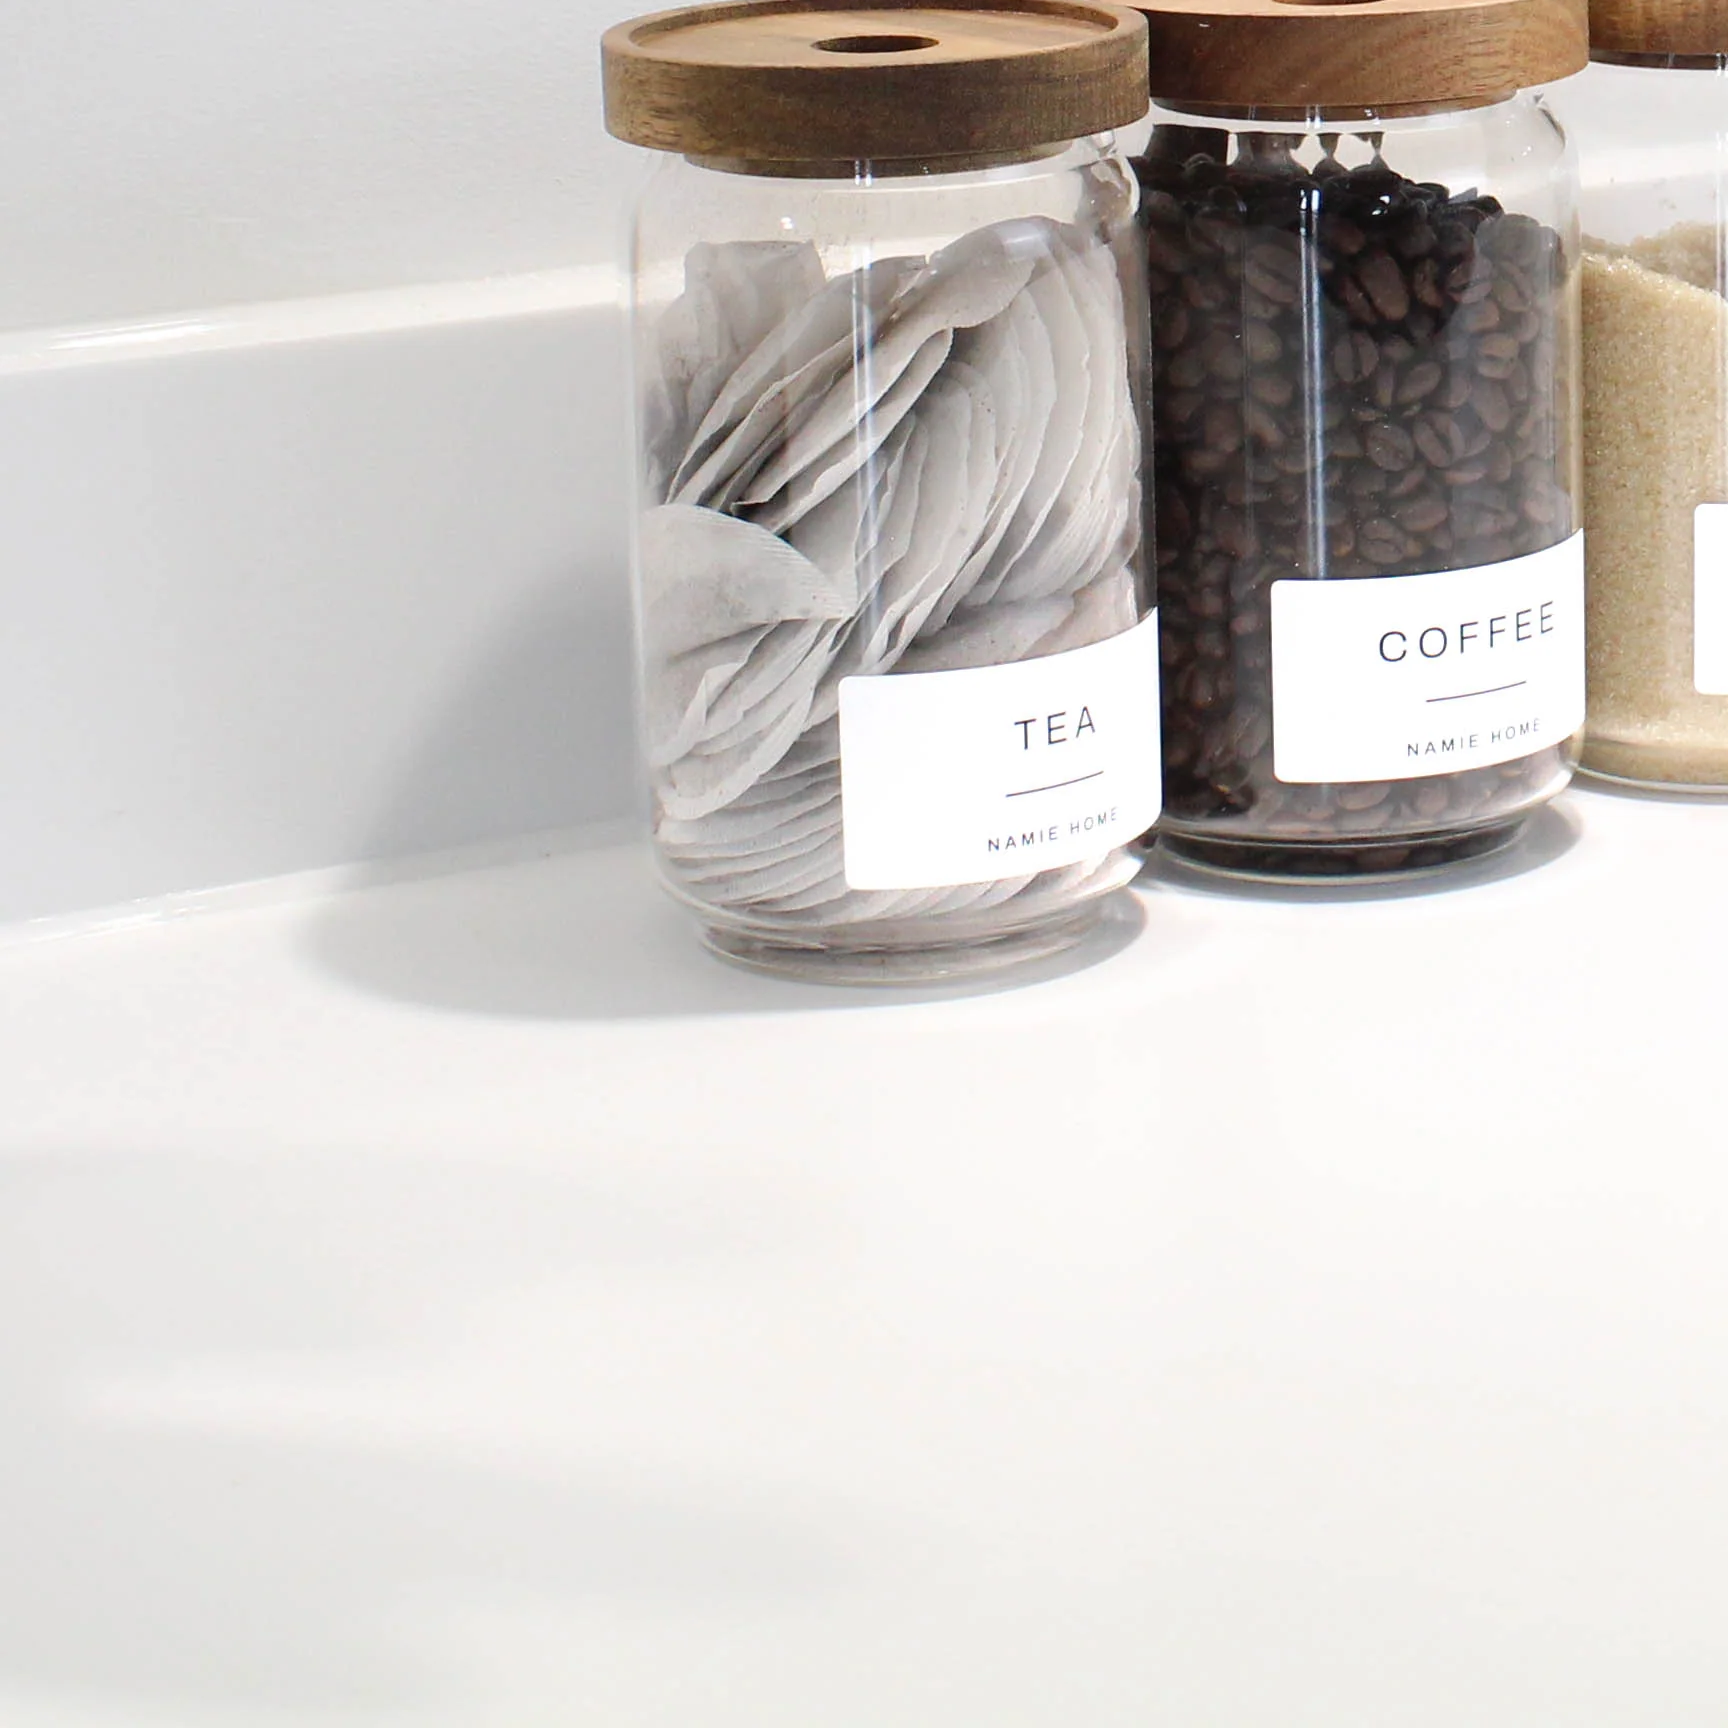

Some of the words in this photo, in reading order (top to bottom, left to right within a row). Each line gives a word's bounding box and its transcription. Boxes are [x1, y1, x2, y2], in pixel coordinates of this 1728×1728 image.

[1377, 599, 1555, 663] COFFEE
[1012, 704, 1097, 752] TEA
[1406, 733, 1479, 758] NAMIE
[1490, 717, 1541, 745] HOME
[986, 824, 1059, 854] NAMIE
[1069, 806, 1119, 835] HOME
